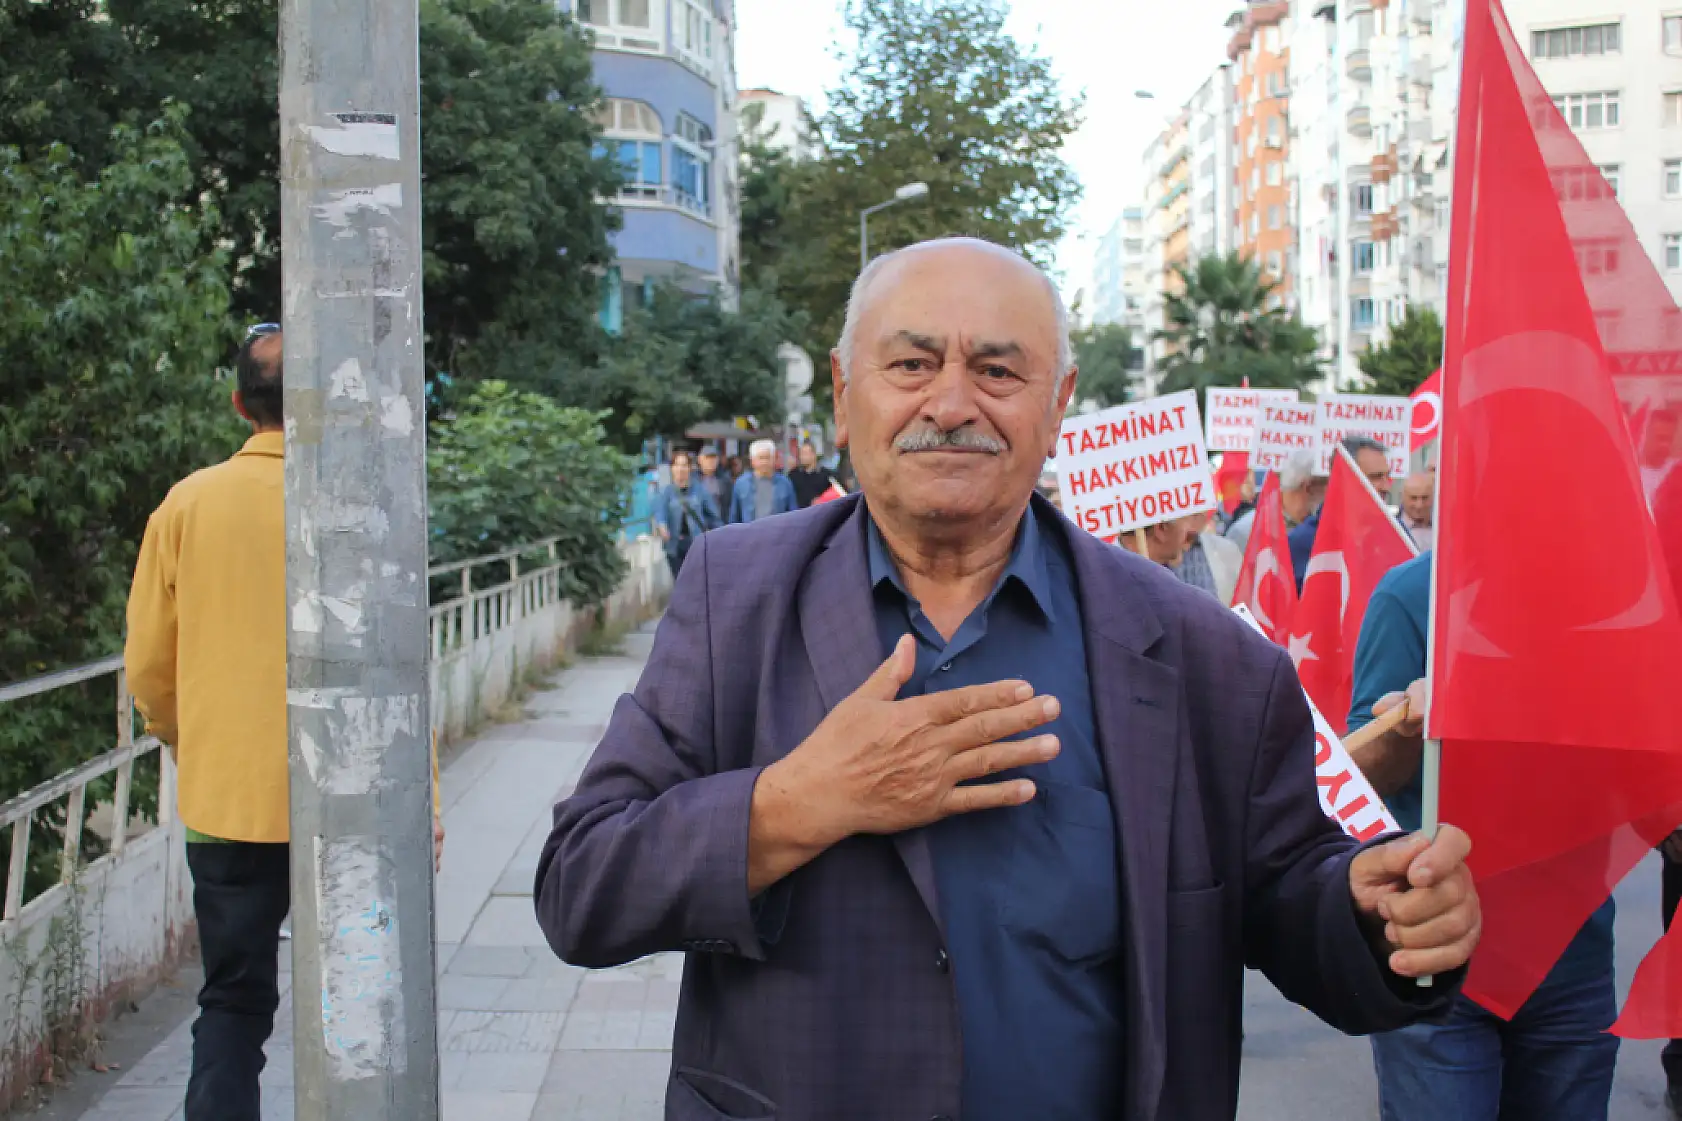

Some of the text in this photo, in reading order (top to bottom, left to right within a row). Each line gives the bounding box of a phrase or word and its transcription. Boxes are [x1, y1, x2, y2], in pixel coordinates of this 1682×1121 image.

[1061, 405, 1186, 457] TAZMİNAT
[1323, 400, 1405, 421] TAZMİNAT
[1068, 443, 1199, 496] HAKKIMIZI
[1074, 482, 1206, 532] İSTİYORUZ
